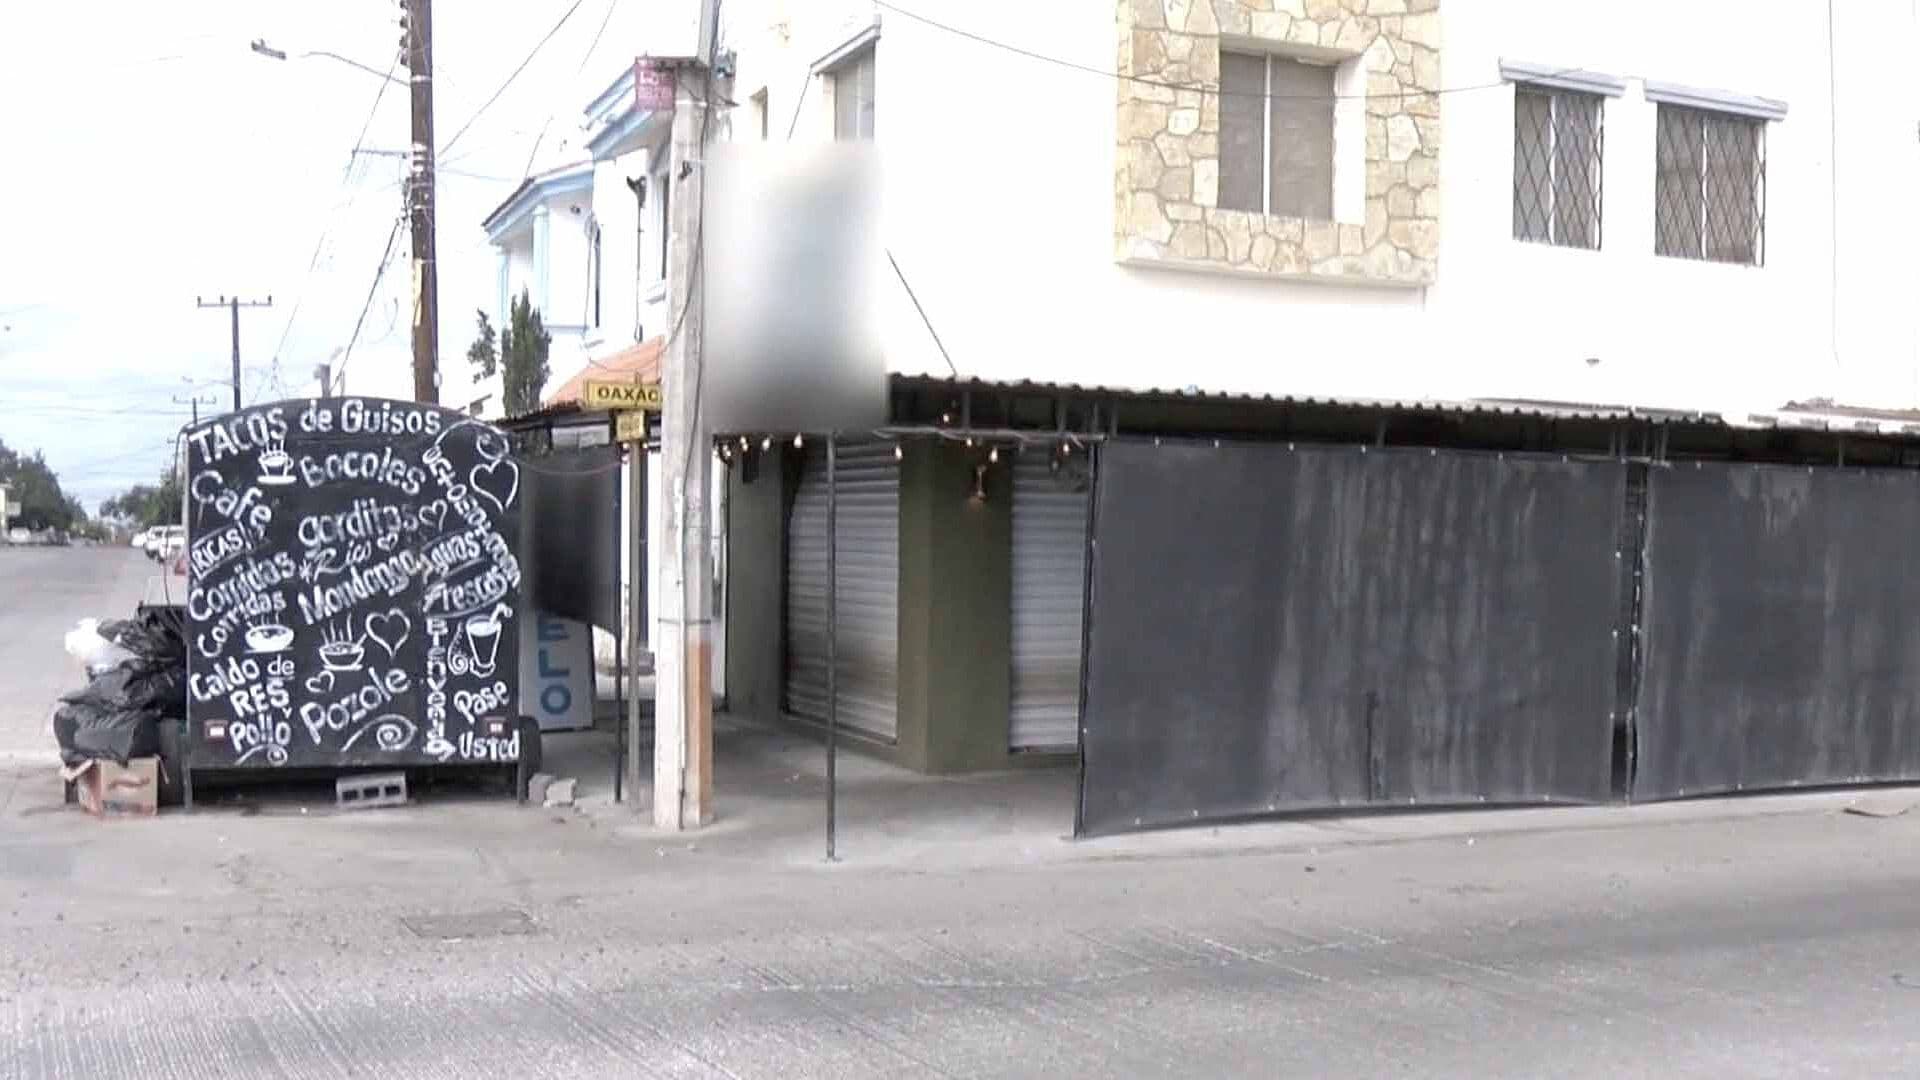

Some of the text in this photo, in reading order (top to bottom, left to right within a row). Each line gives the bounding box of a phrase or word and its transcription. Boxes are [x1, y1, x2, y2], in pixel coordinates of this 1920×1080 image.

[598, 386, 661, 401] OAXAC
[188, 399, 442, 464] TACOS de Guisos
[300, 447, 427, 495] Bocoles
[190, 655, 295, 702] Caldo de
[230, 678, 290, 718] RES
[229, 714, 291, 752] Pollo
[458, 728, 520, 762] Usted
